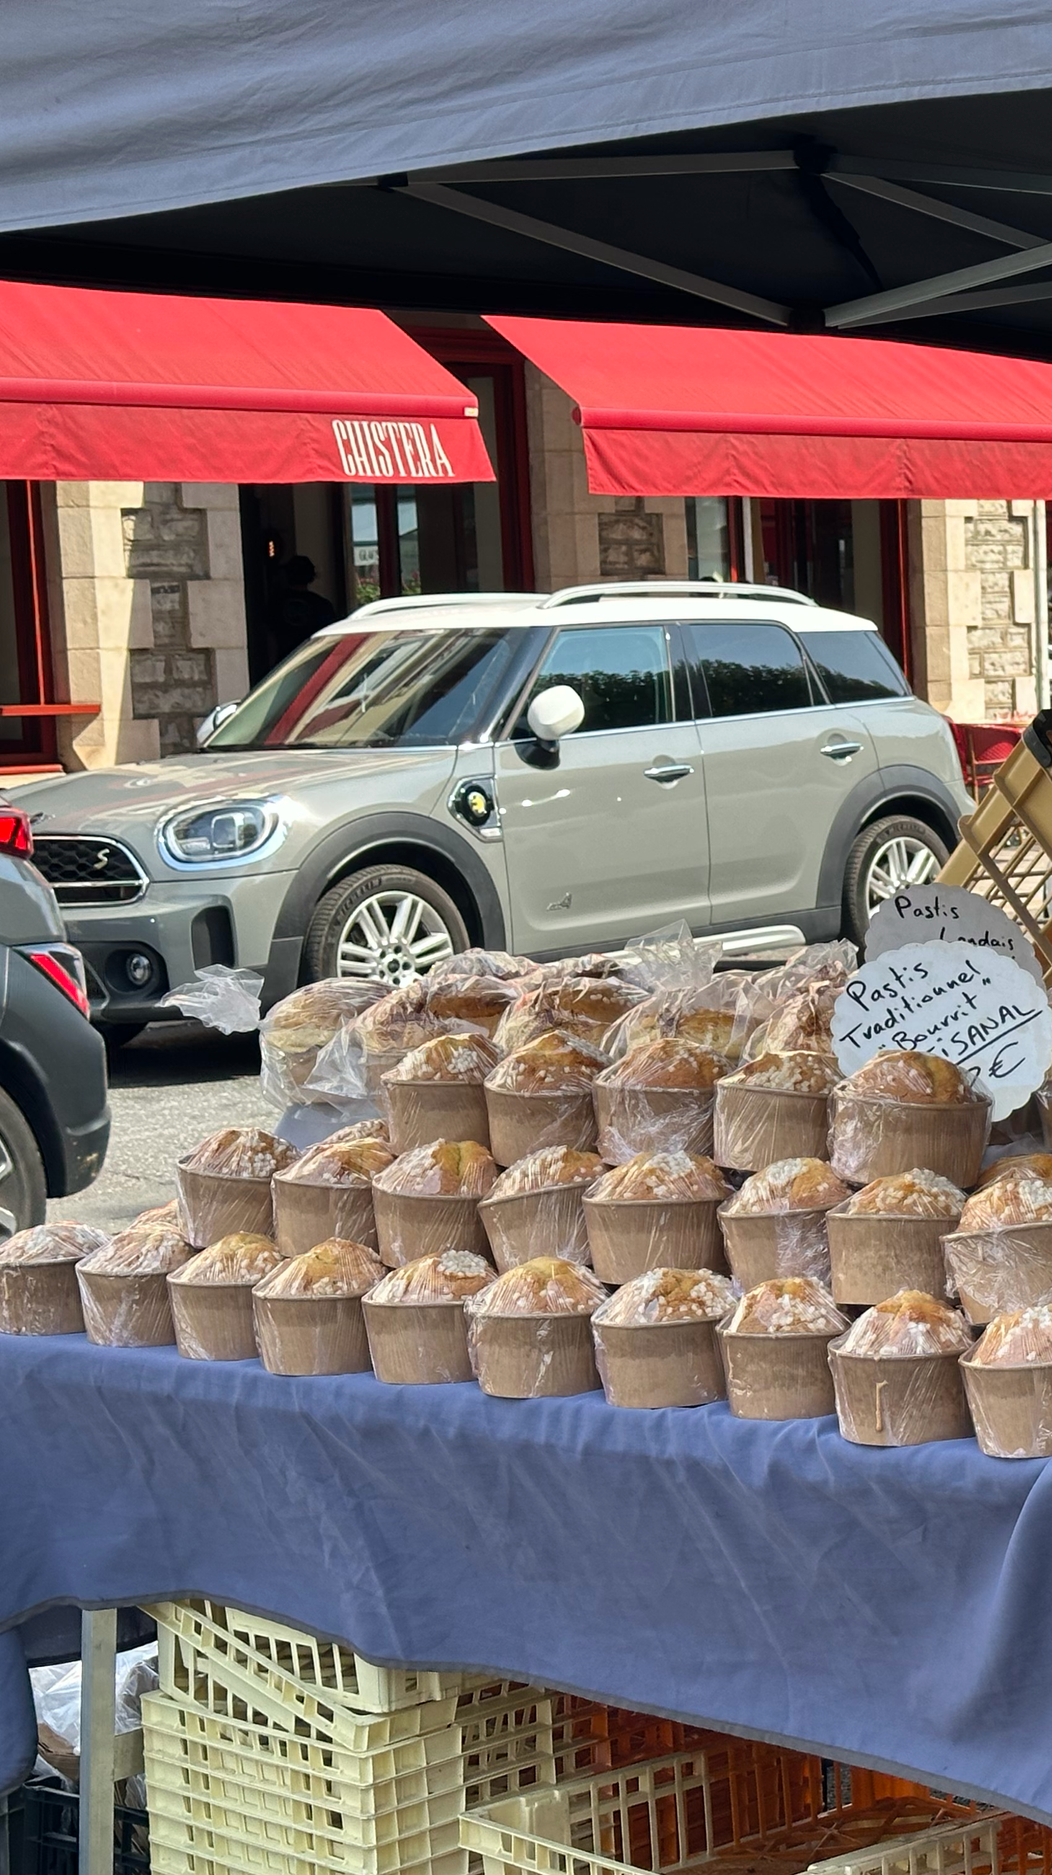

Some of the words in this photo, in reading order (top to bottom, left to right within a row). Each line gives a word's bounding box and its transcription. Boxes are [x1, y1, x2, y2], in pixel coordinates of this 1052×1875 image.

[332, 419, 456, 477] CHISTERA
[894, 895, 960, 919] Pastis
[839, 959, 982, 1049] Traditionnel
[846, 962, 929, 1012] Pastis
